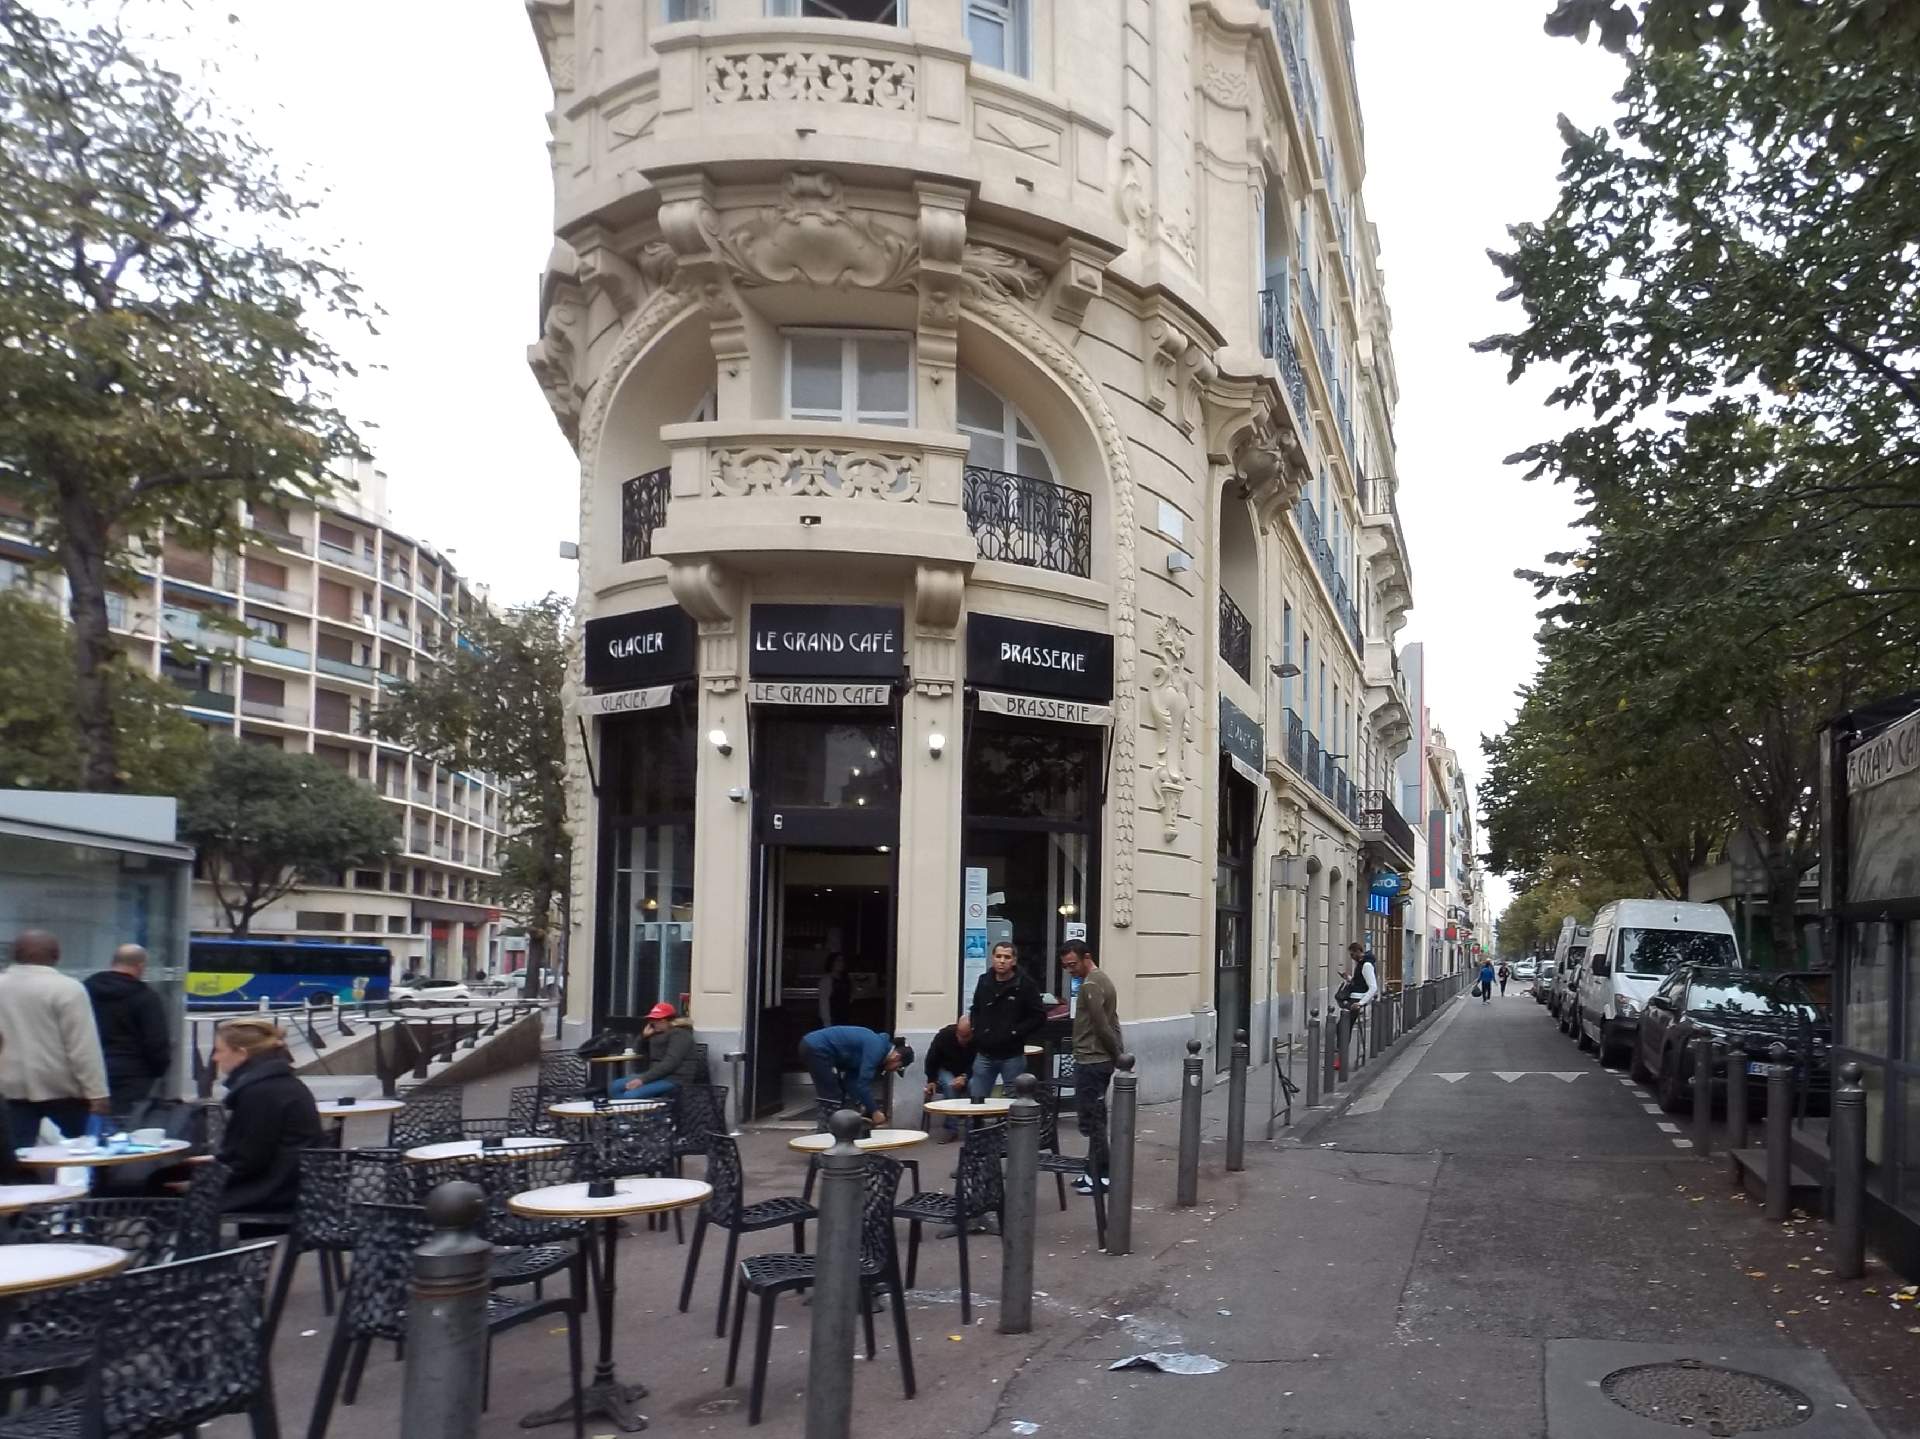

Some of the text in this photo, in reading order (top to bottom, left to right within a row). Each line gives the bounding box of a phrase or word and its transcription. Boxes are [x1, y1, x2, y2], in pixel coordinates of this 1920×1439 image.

[609, 632, 663, 658] GLACIER
[756, 629, 894, 653] LE GRAND CAFÉ
[1001, 642, 1085, 672] BRASSERIE
[601, 691, 648, 711] GLACIER
[755, 684, 776, 701] LE
[780, 685, 837, 704] GRAND
[1007, 697, 1090, 722] BRASSERIE
